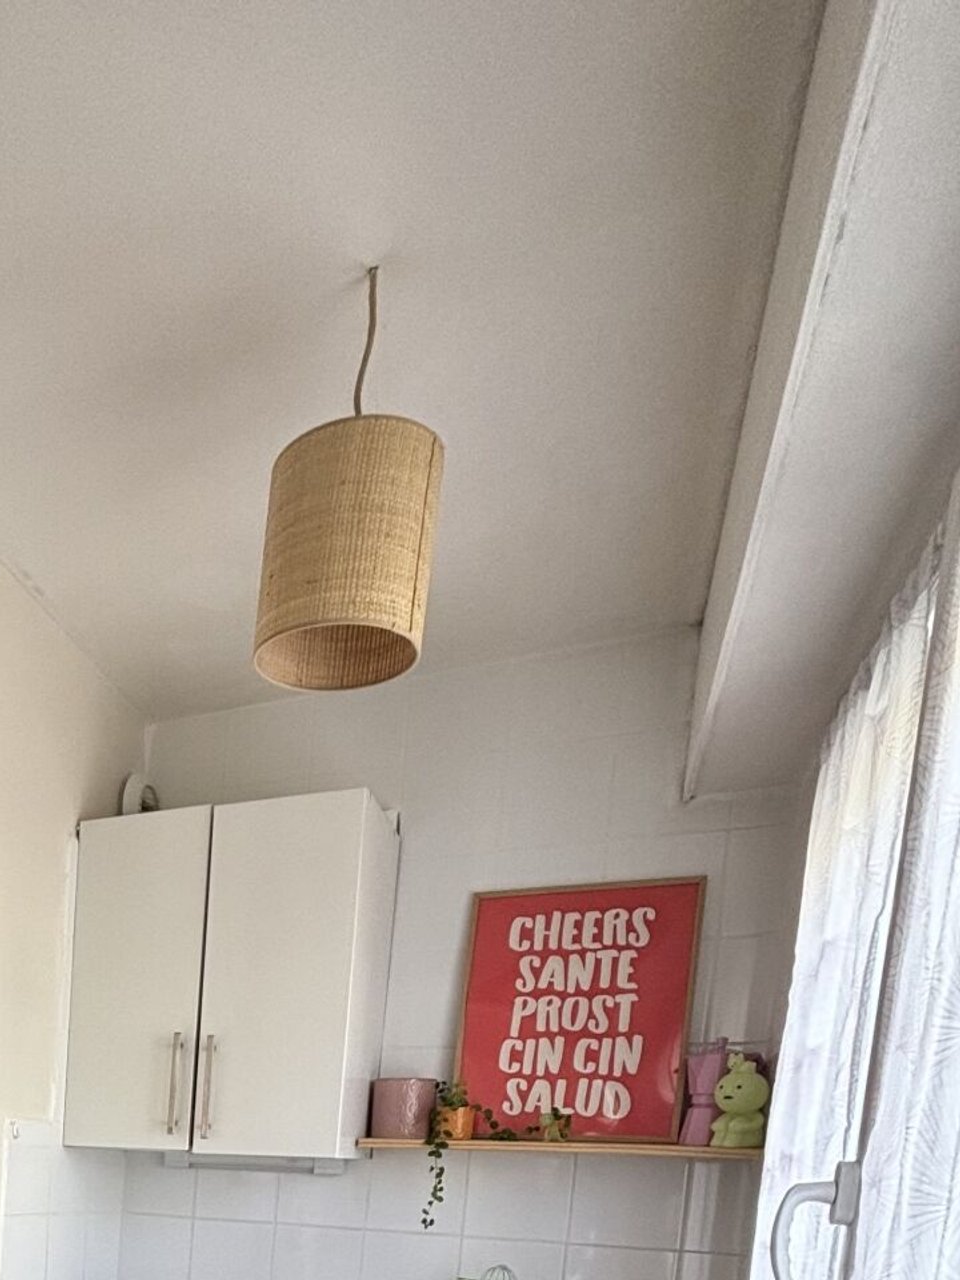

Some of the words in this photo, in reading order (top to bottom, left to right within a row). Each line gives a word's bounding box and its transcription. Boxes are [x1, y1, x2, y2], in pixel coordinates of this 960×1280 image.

[508, 906, 656, 952] CHEERS
[515, 949, 639, 993] SANTE
[509, 993, 639, 1037] PROST
[498, 1035, 565, 1076] CIN
[573, 1034, 643, 1077] CIN
[501, 1078, 632, 1119] SALUD
